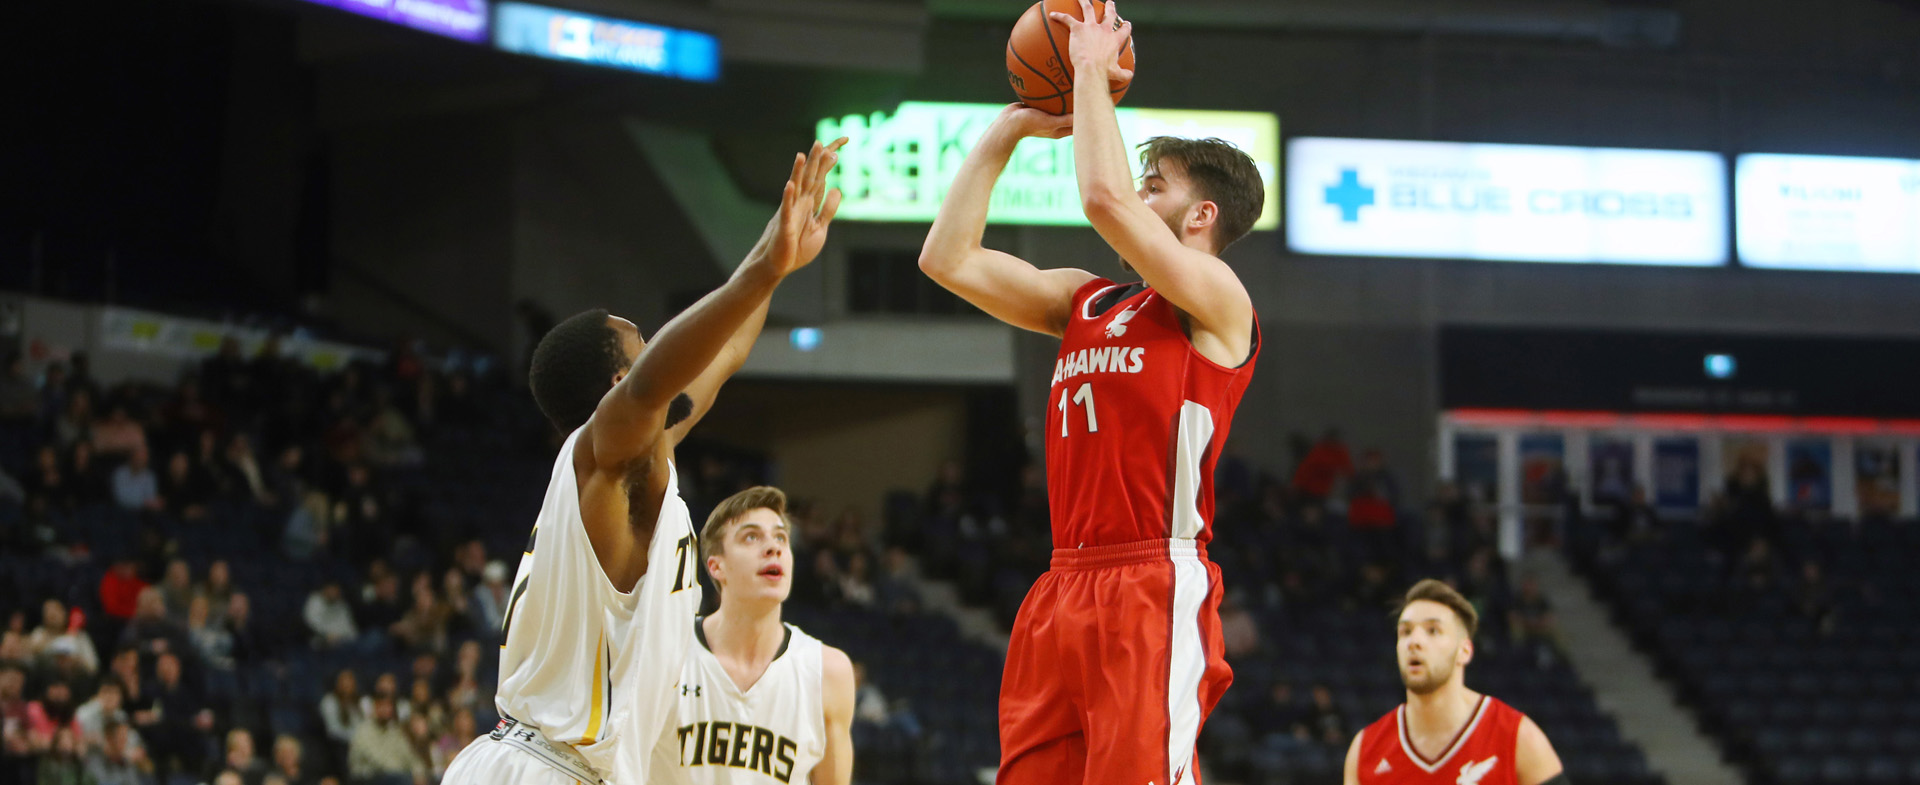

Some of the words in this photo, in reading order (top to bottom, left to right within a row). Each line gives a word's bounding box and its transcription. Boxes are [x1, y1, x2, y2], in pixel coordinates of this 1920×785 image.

[1046, 56, 1069, 87] AUS
[1389, 183, 1512, 213] BLUE
[1528, 188, 1693, 219] CROSS
[1051, 346, 1145, 388] AHAWKS
[1057, 382, 1098, 438] 11
[677, 721, 797, 783] TIGERS
